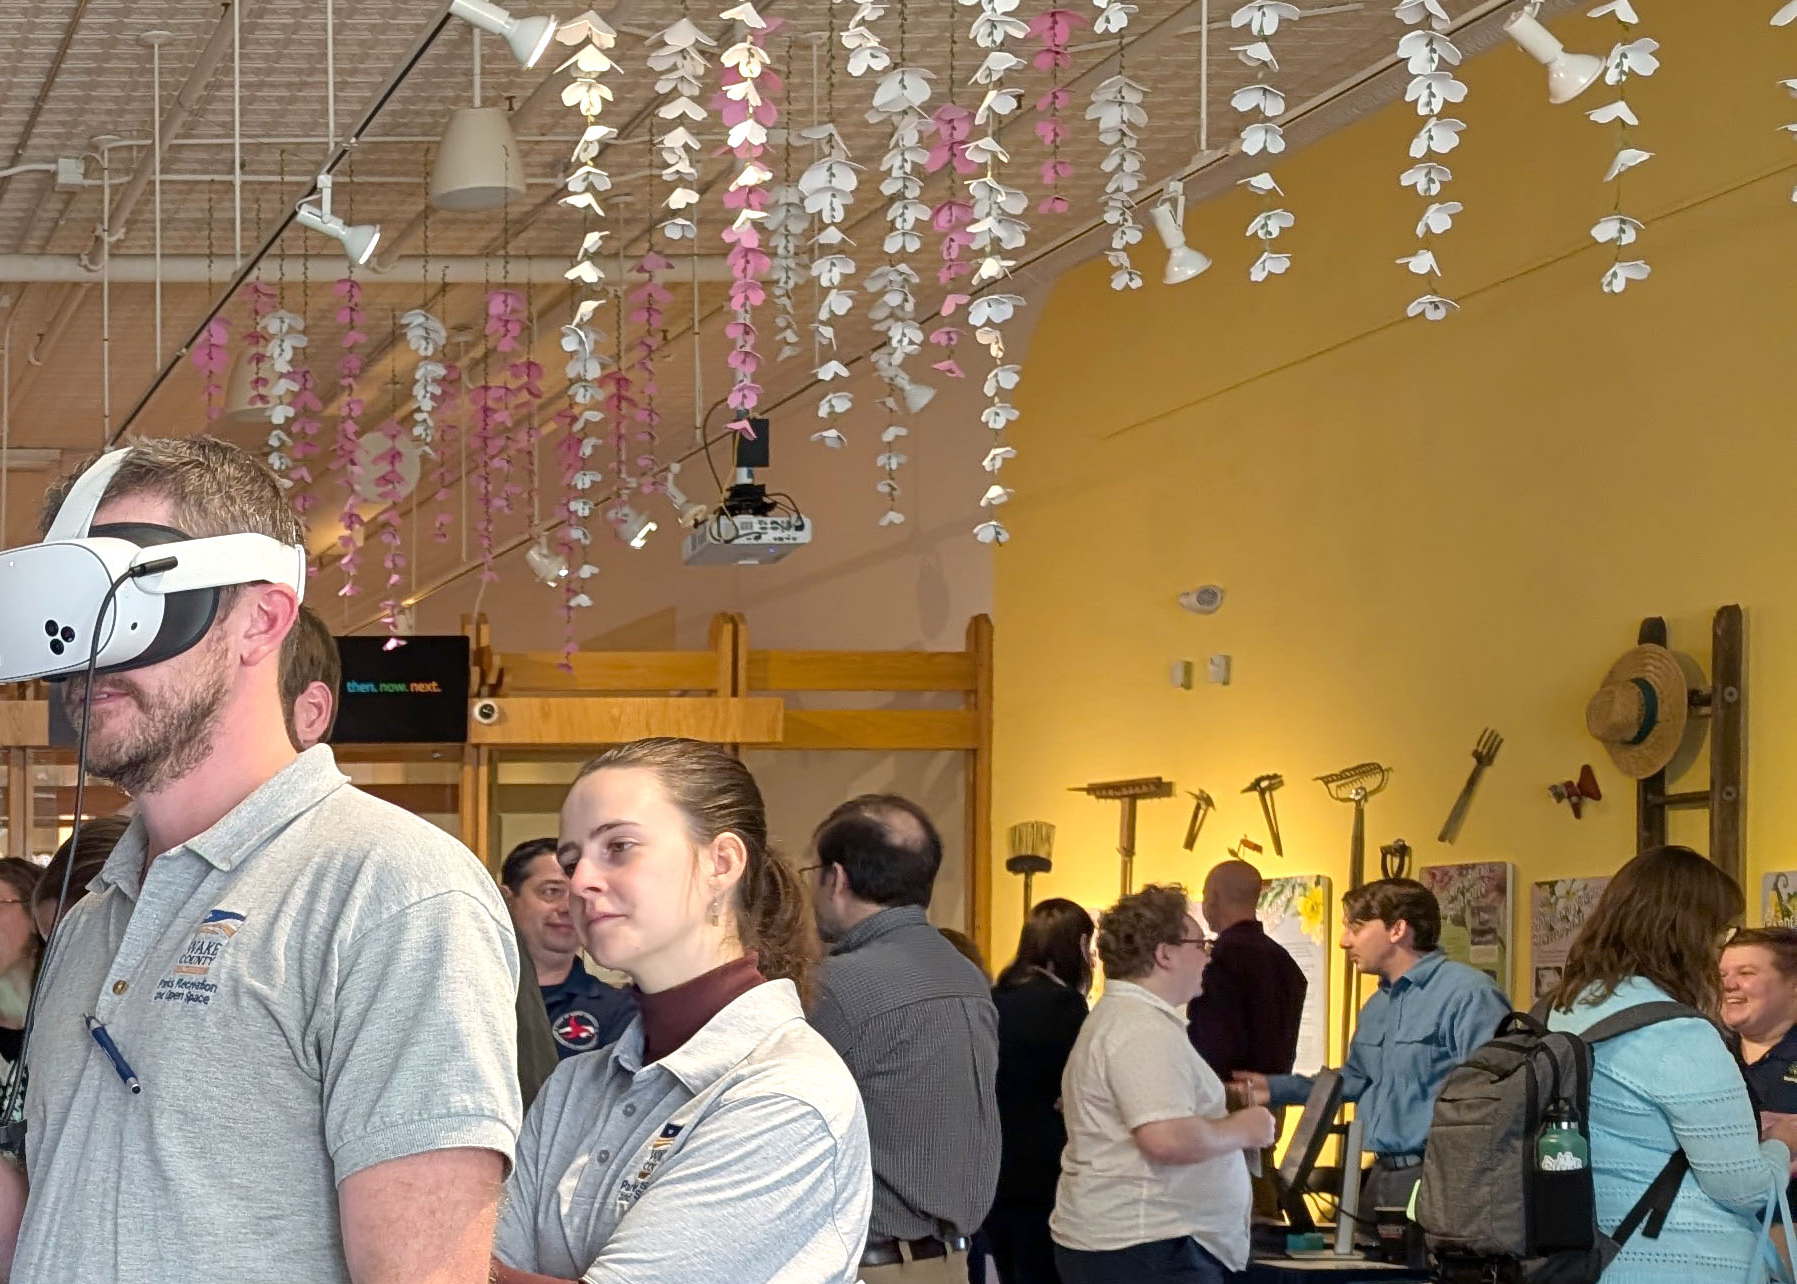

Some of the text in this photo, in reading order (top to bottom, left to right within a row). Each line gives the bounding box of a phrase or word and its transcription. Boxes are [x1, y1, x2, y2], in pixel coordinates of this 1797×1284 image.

[346, 680, 378, 693] then.
[409, 680, 442, 693] next.
[187, 940, 222, 956] WAKE
[178, 955, 216, 966] COUNTY
